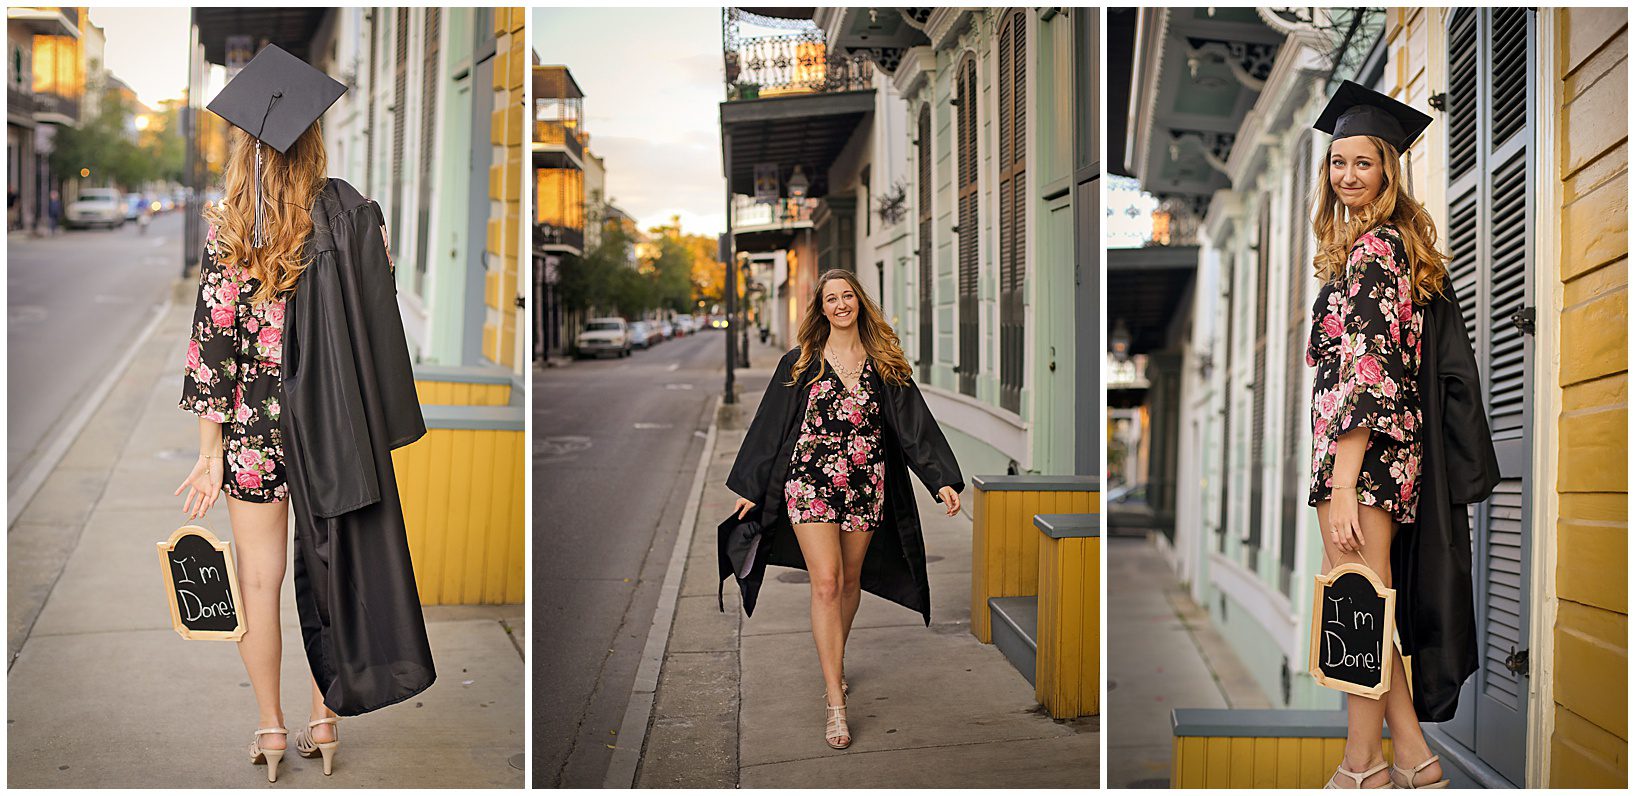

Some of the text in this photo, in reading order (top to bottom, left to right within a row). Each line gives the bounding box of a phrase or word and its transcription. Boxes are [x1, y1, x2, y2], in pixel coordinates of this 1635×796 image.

[173, 556, 221, 585] I'm
[178, 589, 236, 622] Done!
[1327, 596, 1374, 631] I'm
[1324, 630, 1381, 673] Done!
